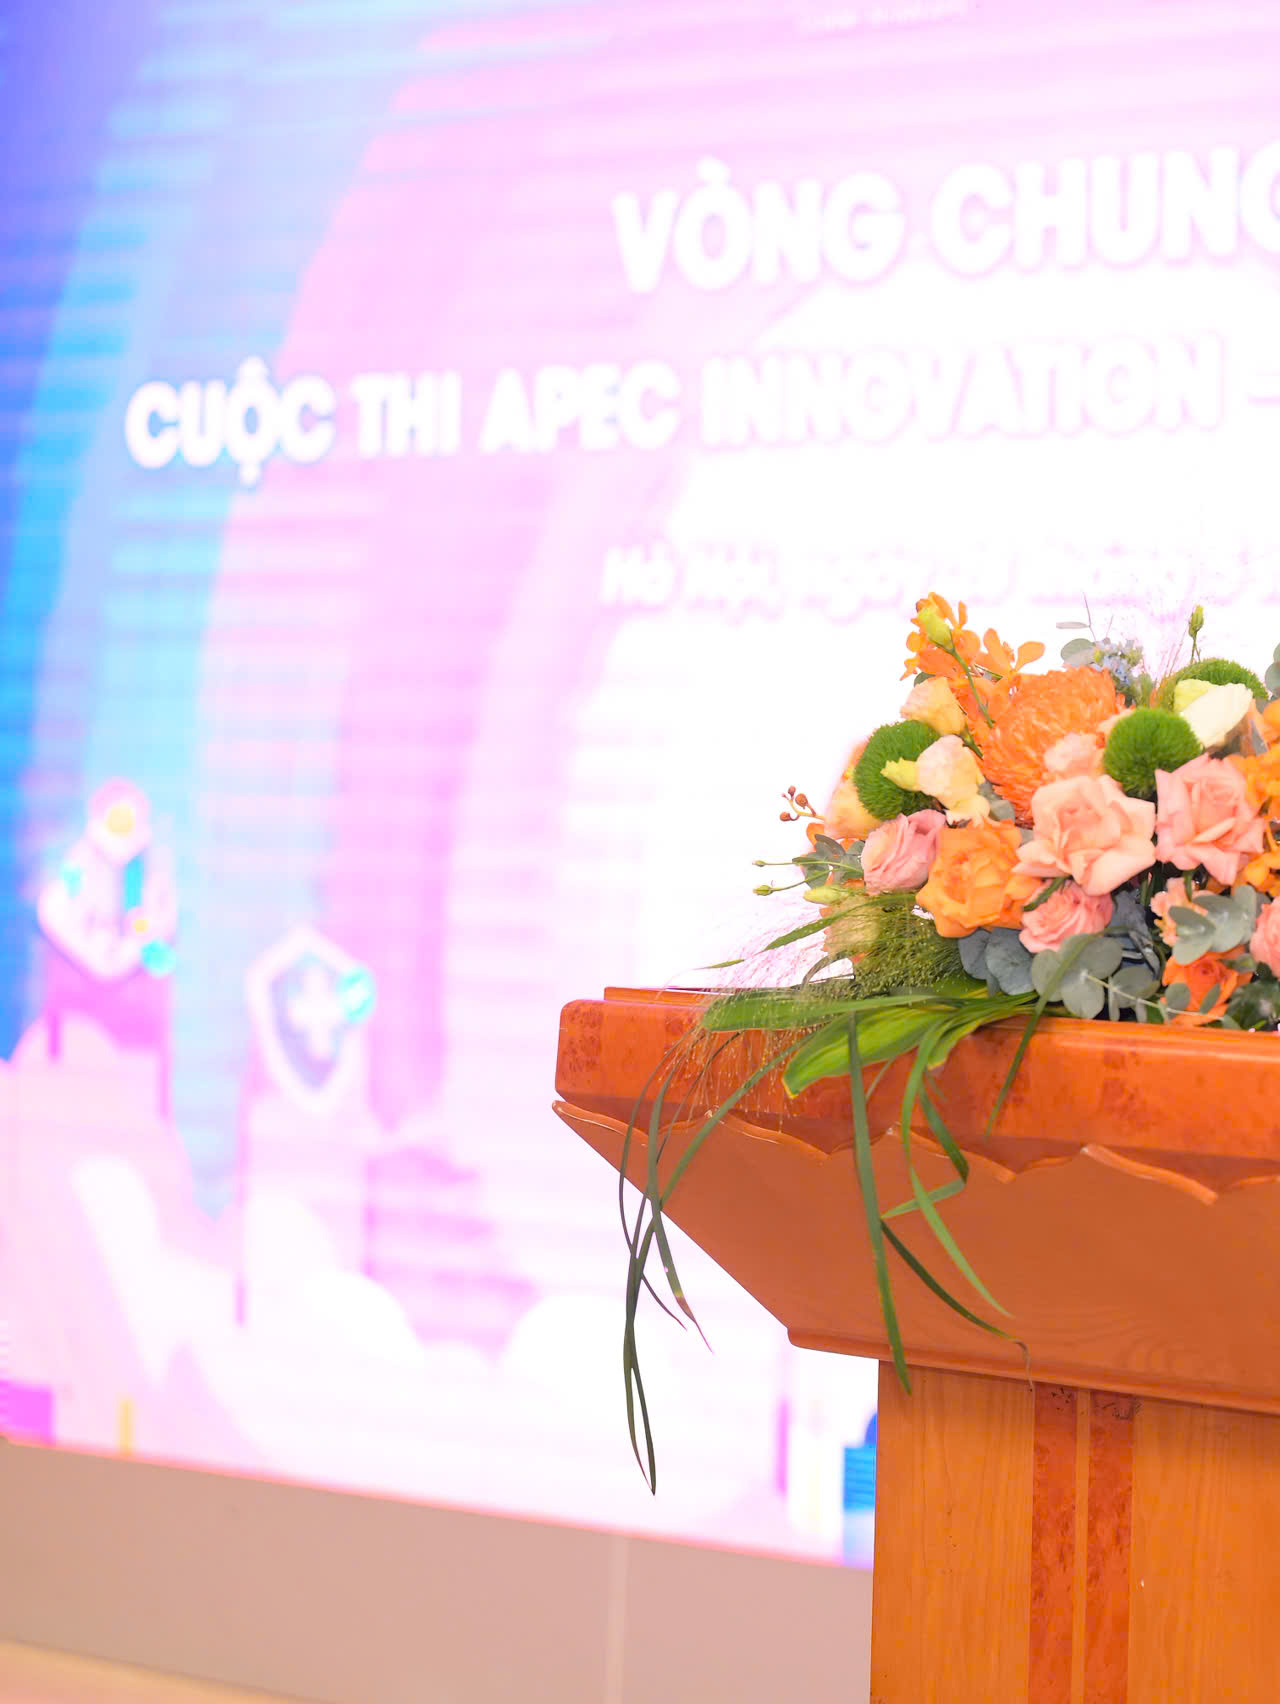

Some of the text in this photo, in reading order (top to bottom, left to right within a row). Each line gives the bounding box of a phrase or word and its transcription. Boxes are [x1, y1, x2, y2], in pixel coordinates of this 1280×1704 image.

[612, 157, 906, 292] VÒNG
[125, 356, 337, 486] CUỘC
[351, 369, 463, 457] THI
[478, 361, 682, 453] APEC
[702, 328, 1227, 448] INNOVATION
